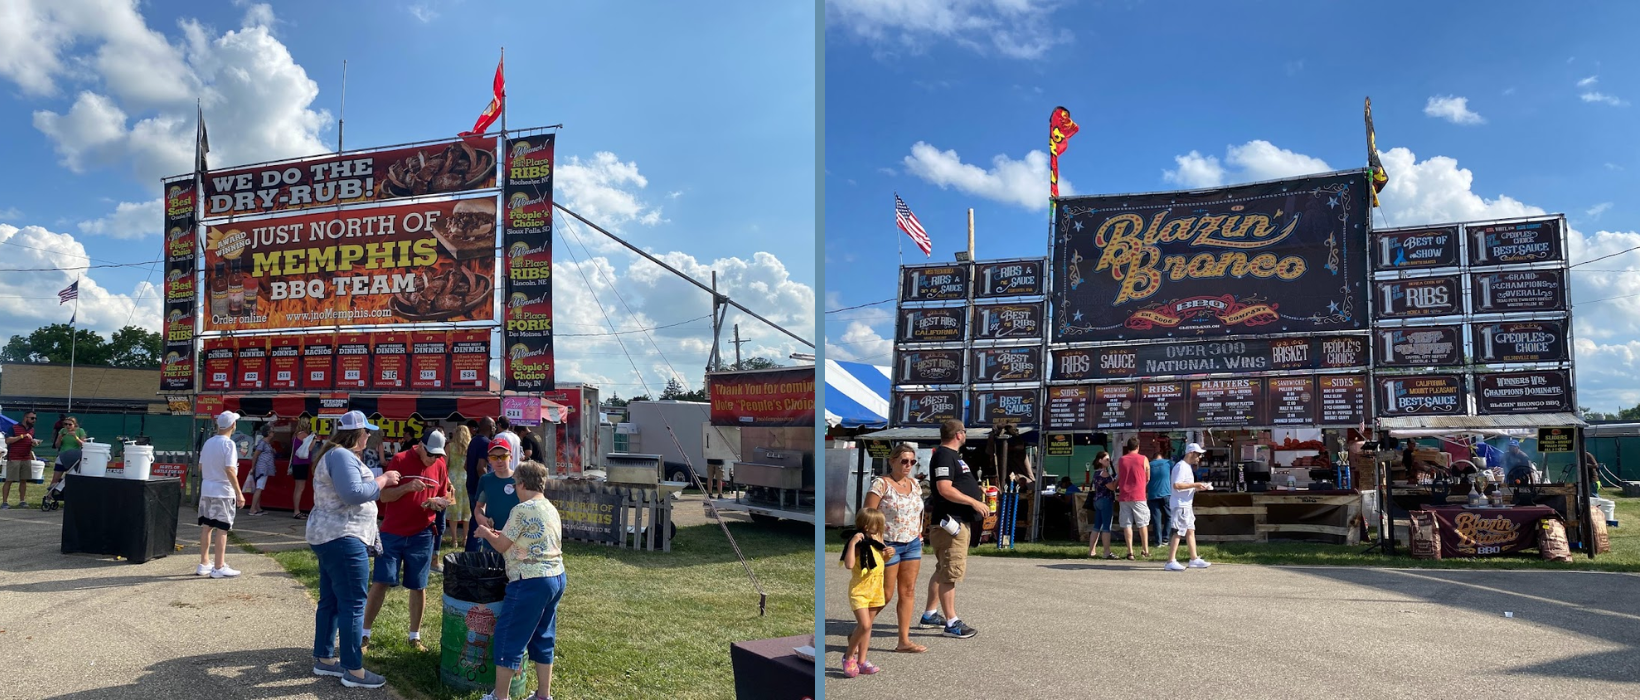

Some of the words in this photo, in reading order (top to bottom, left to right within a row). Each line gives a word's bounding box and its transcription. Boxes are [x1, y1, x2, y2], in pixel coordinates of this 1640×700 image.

[509, 138, 550, 159] Winner!
[525, 158, 549, 168] Place
[212, 173, 253, 193] WE
[260, 167, 302, 188] DO
[310, 157, 374, 181] THE
[510, 165, 550, 179] RIBS
[210, 177, 375, 214] DRY-RUB!
[507, 190, 548, 210] Winner!
[171, 196, 192, 208] Best
[168, 205, 194, 216] Sauce
[509, 209, 549, 220] People's
[251, 224, 304, 249] JUST
[309, 214, 397, 242] NORTH
[402, 210, 441, 234] OF
[512, 219, 545, 228] Choice
[217, 231, 247, 247] AWARD
[1403, 236, 1434, 249] BEST
[1435, 235, 1448, 245] OF
[214, 238, 251, 258] WINNING
[507, 240, 548, 259] Winner!
[1415, 248, 1443, 259] SHOW
[1493, 245, 1518, 257] BEST
[1518, 242, 1550, 255] SAUCE
[251, 237, 438, 277] MEMPHIS
[524, 259, 548, 267] Place
[509, 267, 550, 280] RIBS
[1000, 265, 1022, 278] RIBS
[1025, 266, 1032, 274] &
[1112, 245, 1309, 305] Bronco
[171, 280, 192, 290] Best
[270, 279, 326, 301] BBQ
[332, 272, 417, 296] TEAM
[931, 275, 952, 286] RIBS
[1010, 275, 1035, 288] SAUCE
[1499, 281, 1548, 289] CHAMPIONS
[168, 290, 194, 299] Sauce
[940, 284, 963, 294] SAUCE
[1505, 289, 1542, 297] OVERALL
[507, 291, 547, 310] Winner!
[1405, 286, 1449, 308] RIBS
[1176, 299, 1226, 312] BBQ
[211, 313, 238, 325] Order
[239, 312, 267, 325] online
[285, 308, 392, 322] www.jnoMemphis.com
[524, 311, 547, 320] Place
[1000, 309, 1031, 321] BEST
[1228, 306, 1268, 322] COMPANY
[506, 319, 551, 331] PORK
[919, 317, 940, 328] BEST
[940, 316, 957, 327] RIBS
[1012, 319, 1036, 328] RIBS
[168, 329, 193, 341] RIBS
[1503, 332, 1545, 344] PEOPLES
[304, 348, 332, 356] NACHOS
[508, 343, 549, 361] Winner!
[1165, 345, 1207, 358] OVER
[1209, 341, 1246, 355] 300
[1272, 344, 1309, 363] BRISKET
[1322, 341, 1361, 354] PEOPLE'S
[1515, 342, 1549, 353] CHOICE
[208, 351, 233, 359] DINNER
[997, 352, 1030, 364] BEST
[1100, 353, 1136, 369] SAUCE
[1326, 352, 1356, 364] CHOICE
[510, 362, 550, 373] People's
[917, 359, 938, 370] BEST
[938, 358, 956, 370] RIBS
[1011, 362, 1034, 372] RIBS
[1060, 354, 1090, 374] RIBS
[1223, 355, 1266, 369] WINS
[382, 371, 397, 379] $16
[513, 371, 546, 380] Choice
[1201, 379, 1250, 389] PLATTERS
[1331, 378, 1354, 387] SIDES
[1496, 377, 1530, 387] WINNERS
[714, 383, 743, 395] Thank
[744, 383, 762, 395] You
[763, 382, 778, 394] for
[1060, 388, 1079, 397] SIDES
[1148, 385, 1175, 393] RIBS
[1428, 386, 1458, 394] PLEASANT
[1483, 387, 1524, 398] CHAMPIONS
[714, 400, 734, 411] Vote
[735, 399, 783, 412] "People's
[920, 395, 950, 407] BEST
[999, 395, 1023, 408] BEST
[1398, 396, 1424, 408] BEST
[1424, 395, 1457, 408] SAUCE
[931, 403, 954, 413] RIBS
[1005, 404, 1032, 415] SAUCE
[565, 500, 598, 511] NORTH
[600, 503, 614, 512] OF
[560, 509, 613, 525] EMPHIS
[1477, 546, 1500, 555] BBQ
